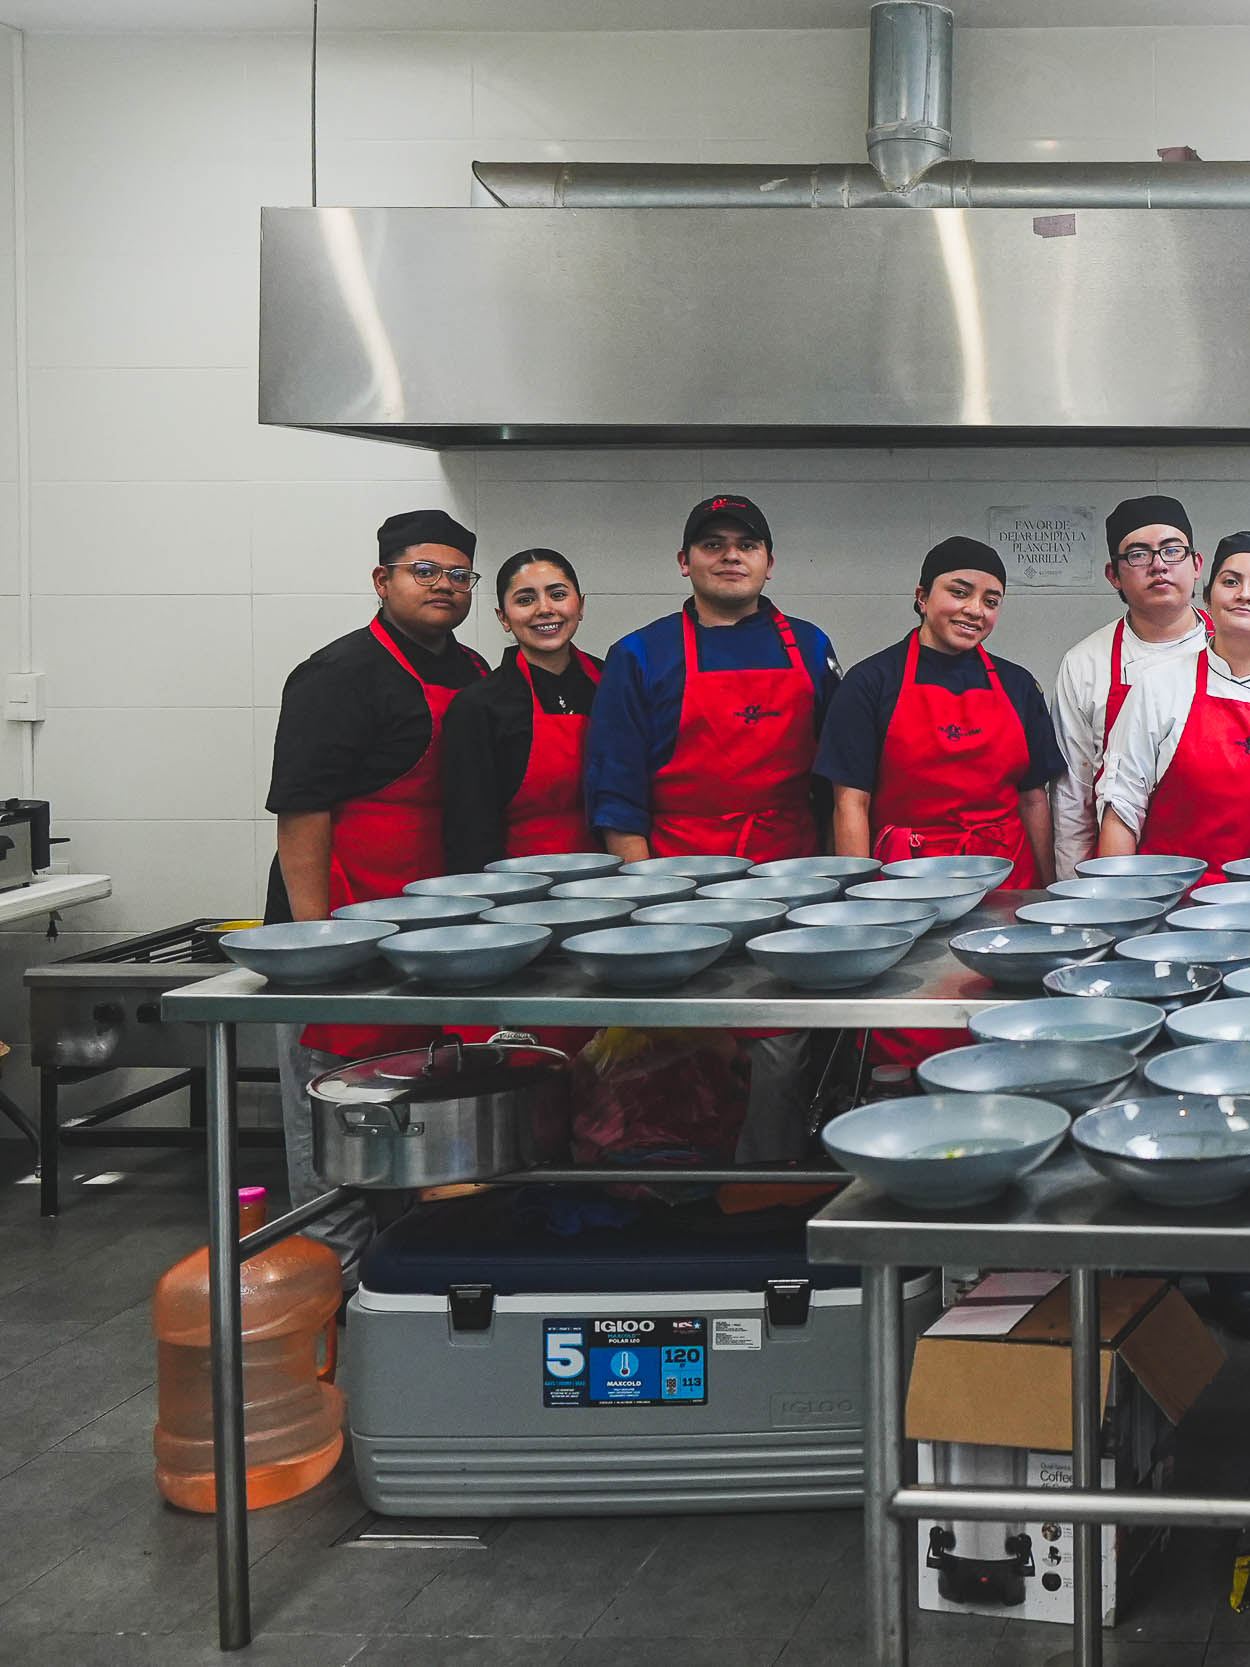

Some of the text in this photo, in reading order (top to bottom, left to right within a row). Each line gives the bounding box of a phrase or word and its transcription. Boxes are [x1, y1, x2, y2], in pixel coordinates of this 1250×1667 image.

[1015, 520, 1070, 530] FAVOR DE
[1000, 531, 1087, 541] DEJAR LIMPIA LA
[1013, 542, 1073, 552] PLANCHA Y
[1017, 554, 1068, 563] PARRILLA
[594, 1320, 655, 1333] IGLOO
[546, 1333, 585, 1378] 5
[664, 1348, 700, 1363] 120
[682, 1377, 702, 1387] 113
